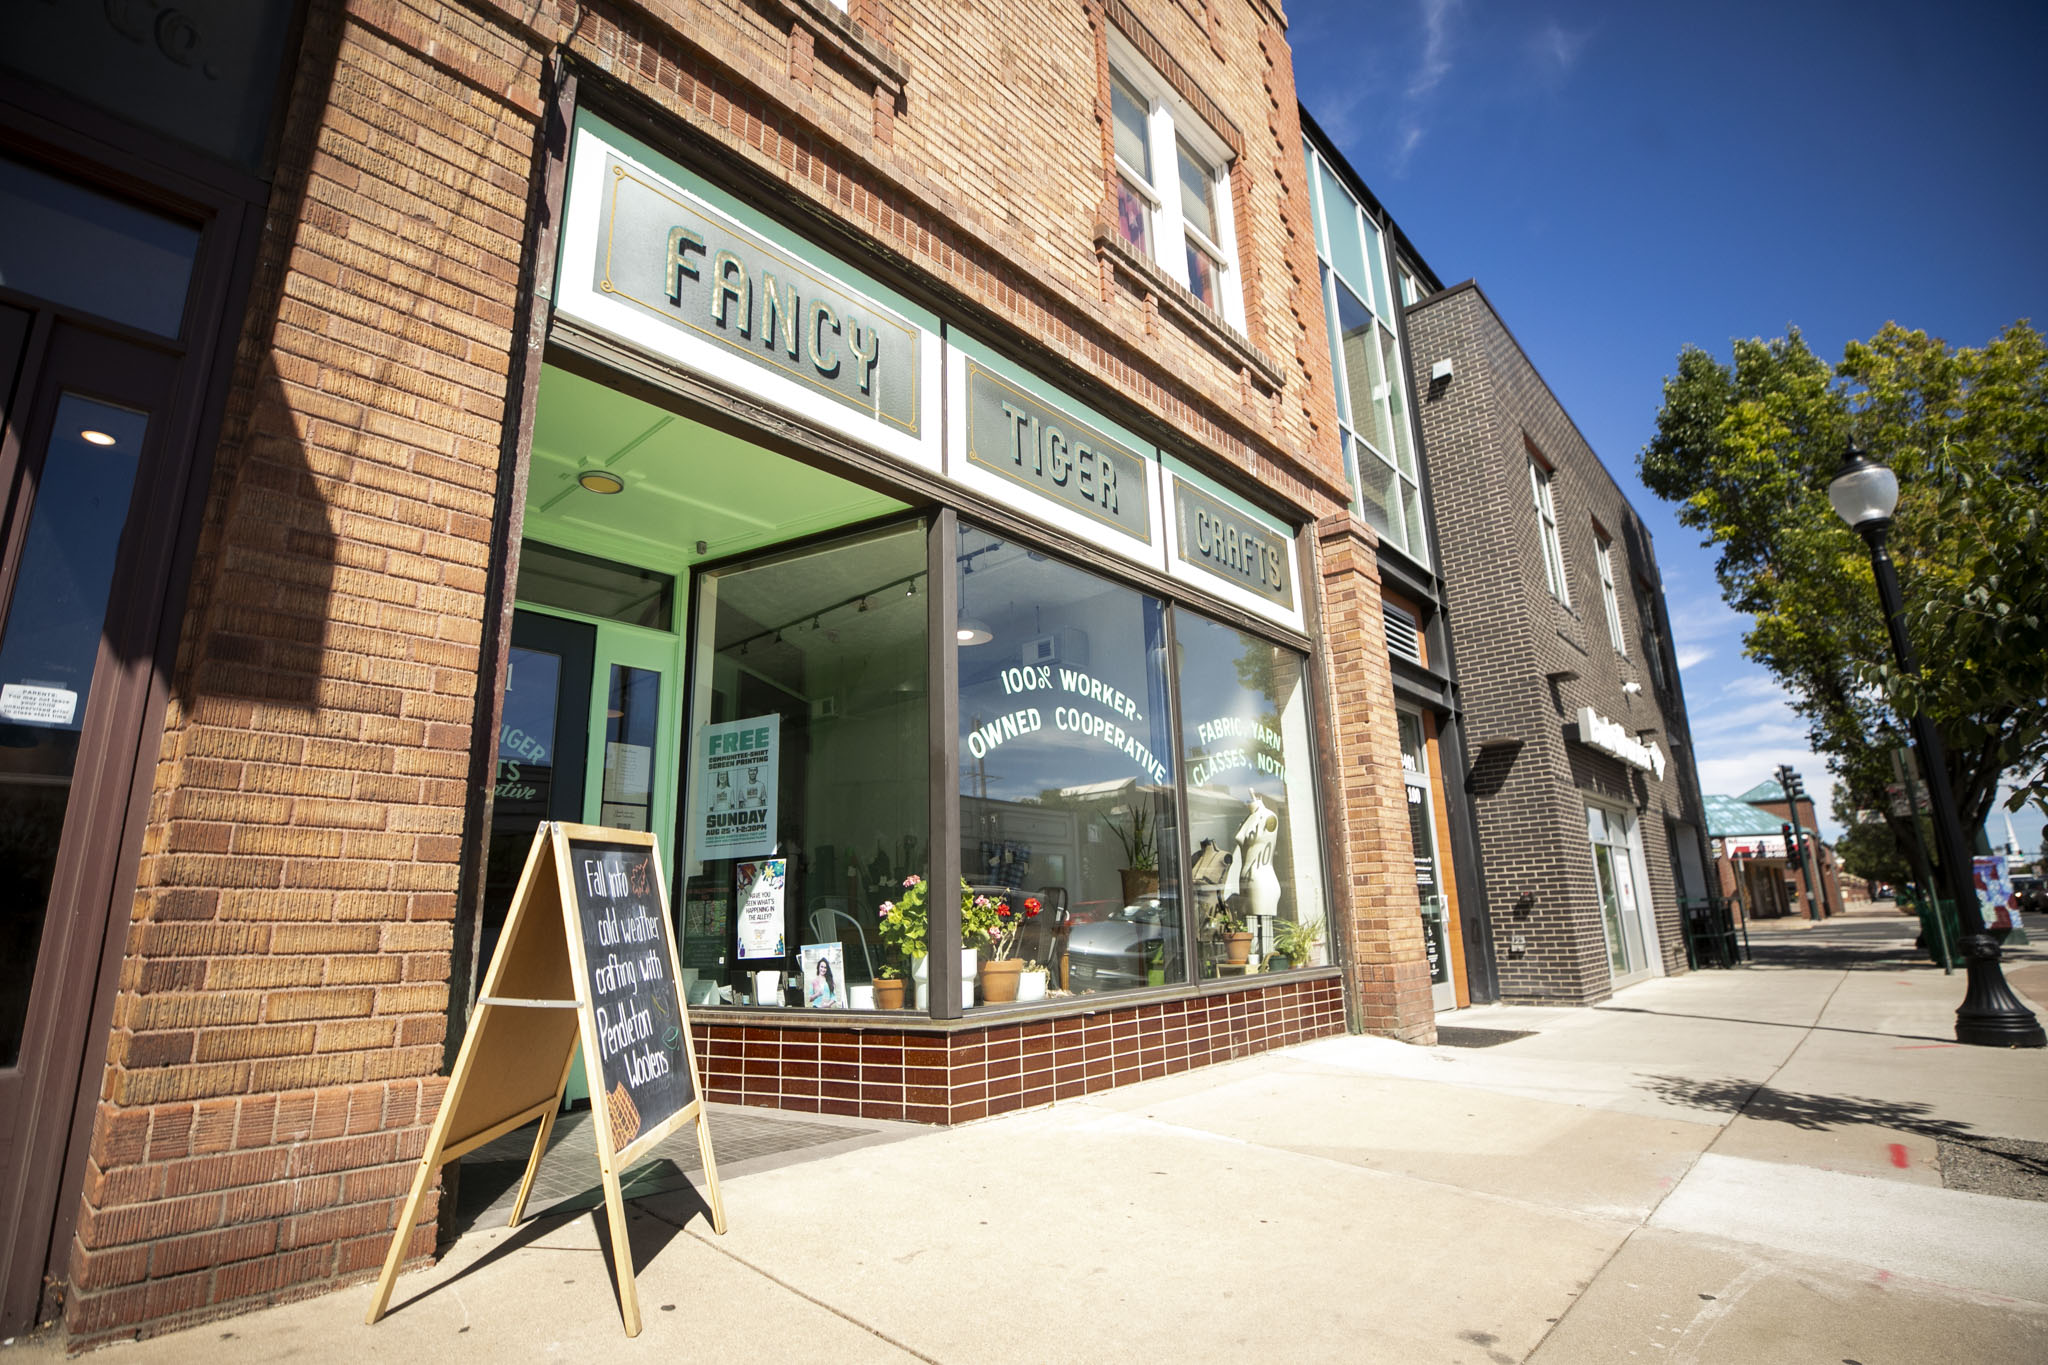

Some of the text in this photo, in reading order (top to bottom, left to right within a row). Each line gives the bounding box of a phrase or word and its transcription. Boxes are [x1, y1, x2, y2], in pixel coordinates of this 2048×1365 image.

[664, 225, 1283, 592] FANCY TIGER CRAFTS
[1000, 665, 1143, 721] 100% WORKER-
[499, 723, 546, 765] IGER
[709, 727, 770, 756] FREE
[967, 706, 1166, 786] OWNED COOPERATIVE
[708, 756, 769, 770] SCREEN PRINTING
[705, 828, 720, 836] AUG
[706, 809, 768, 828] SUNDAY
[584, 860, 629, 898] Fall into
[597, 905, 660, 946] cold weather
[757, 913, 772, 921] ALLEY?
[595, 949, 663, 995] crafting with
[596, 999, 653, 1061] Pendleton
[624, 1043, 669, 1089] Woolens
